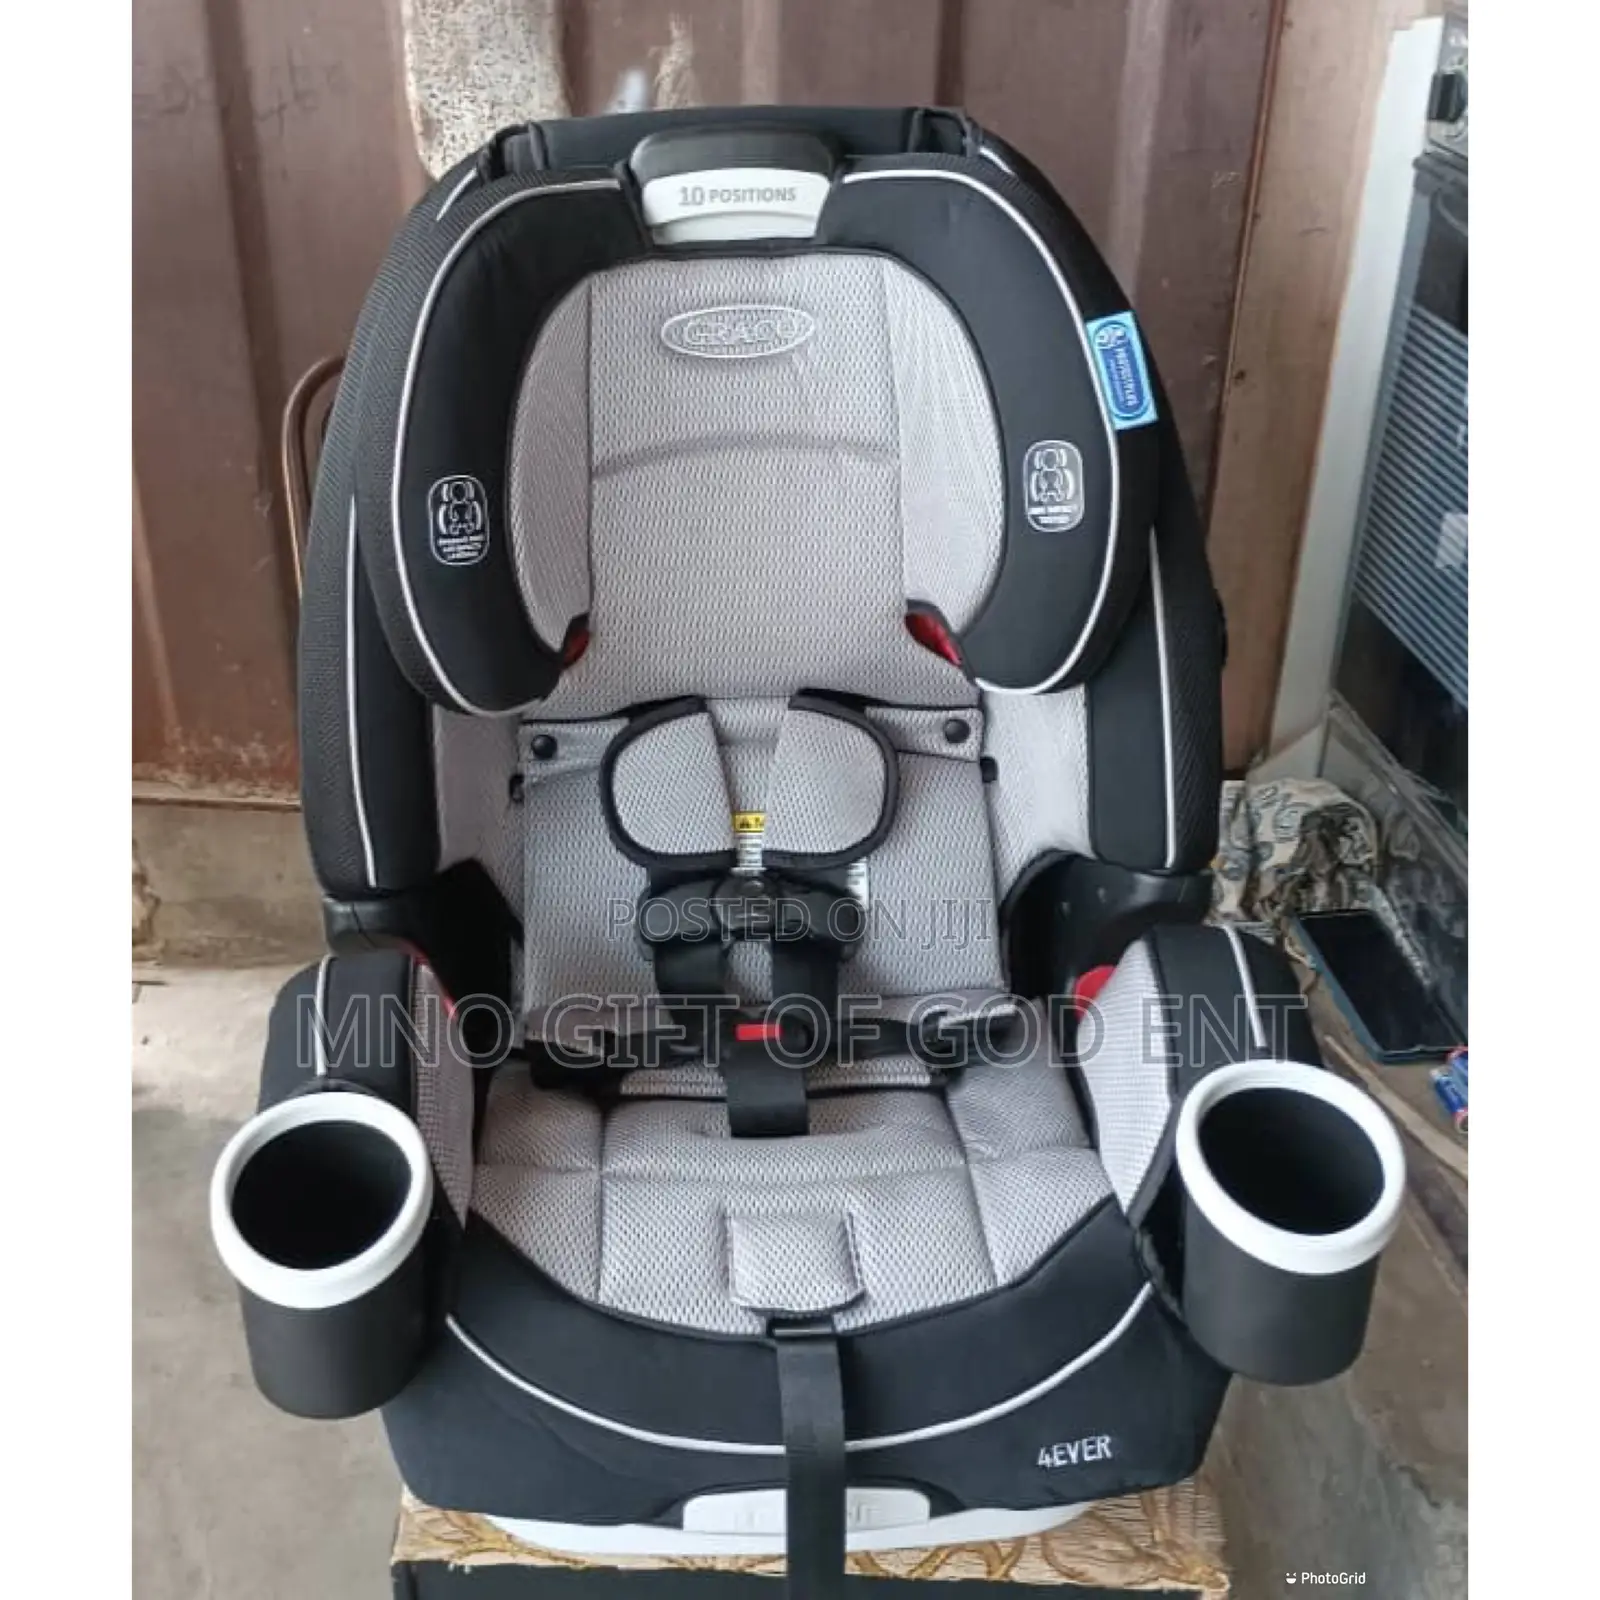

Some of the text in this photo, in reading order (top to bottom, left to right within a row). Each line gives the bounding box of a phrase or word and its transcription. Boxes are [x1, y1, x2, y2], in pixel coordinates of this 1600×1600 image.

[678, 186, 798, 206] 10 POSITIONS
[1036, 1434, 1113, 1470] 4EVER
